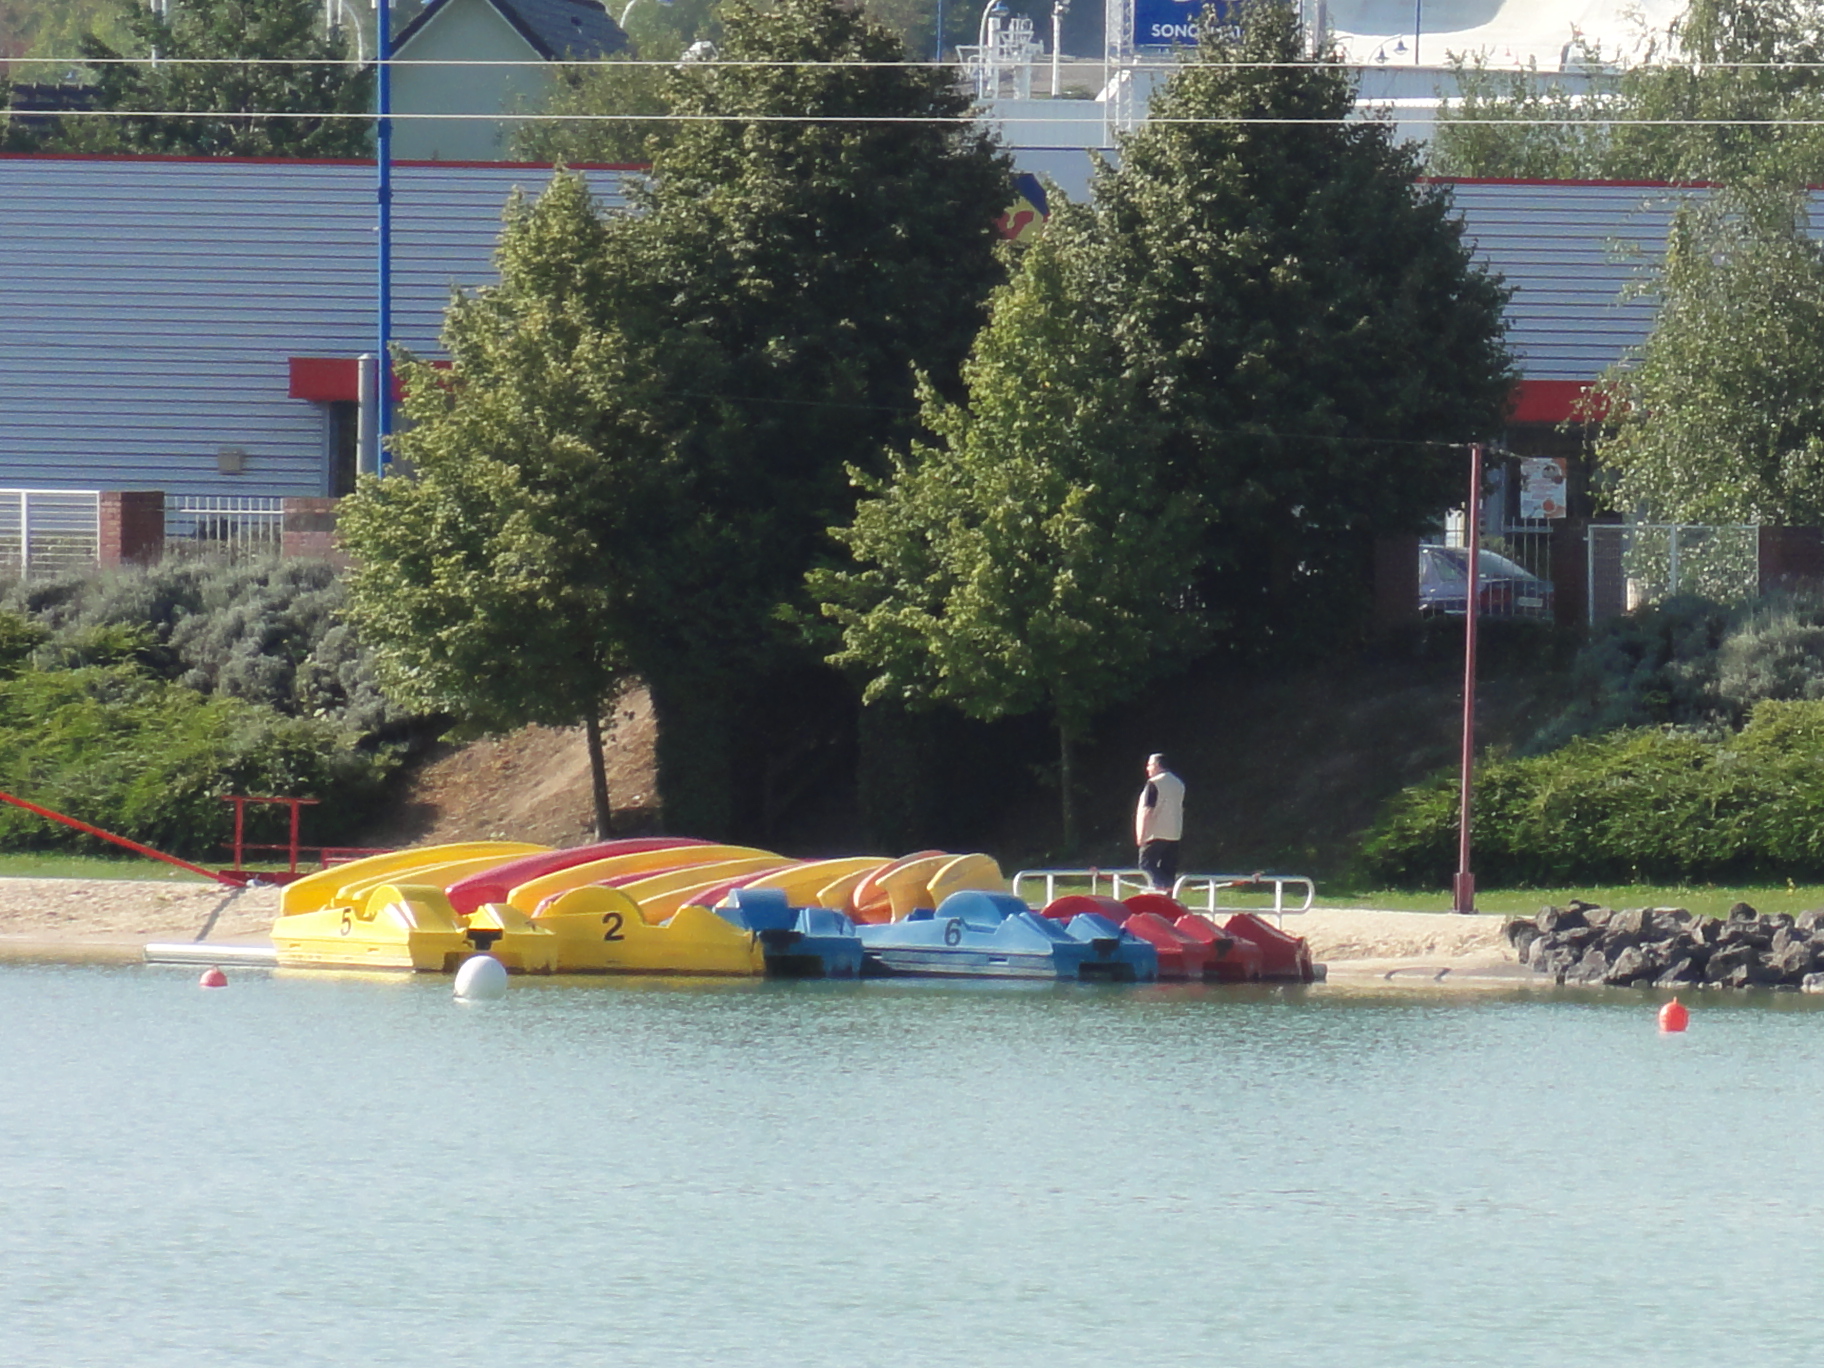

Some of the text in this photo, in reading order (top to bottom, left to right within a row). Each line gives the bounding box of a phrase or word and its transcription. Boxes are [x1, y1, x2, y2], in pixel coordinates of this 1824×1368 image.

[340, 907, 352, 937] 5
[602, 911, 625, 941] 2
[944, 918, 962, 947] 6
